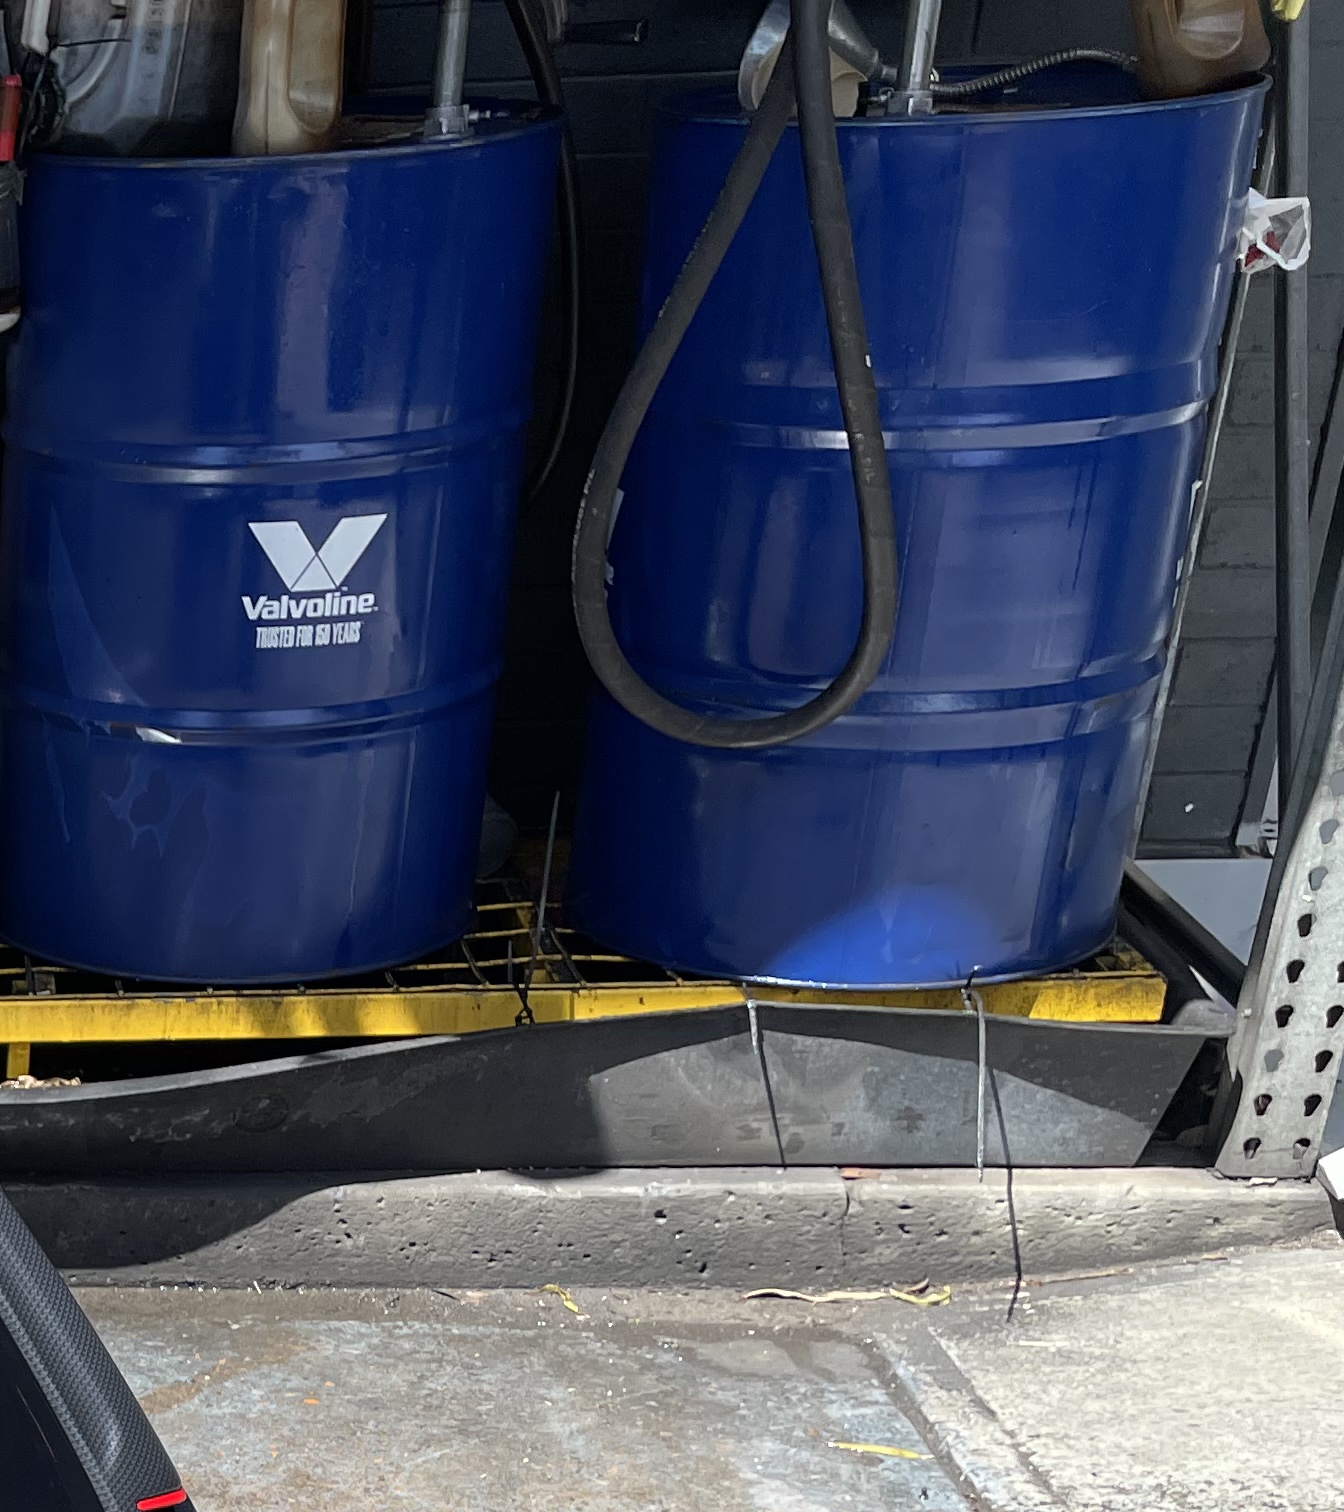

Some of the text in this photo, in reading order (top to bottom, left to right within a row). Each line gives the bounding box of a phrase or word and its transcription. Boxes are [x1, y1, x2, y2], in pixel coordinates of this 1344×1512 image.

[241, 592, 376, 621] Valvoline
[255, 626, 296, 648] TRUSTED
[295, 624, 314, 647] FOR
[332, 621, 362, 645] YEARS
